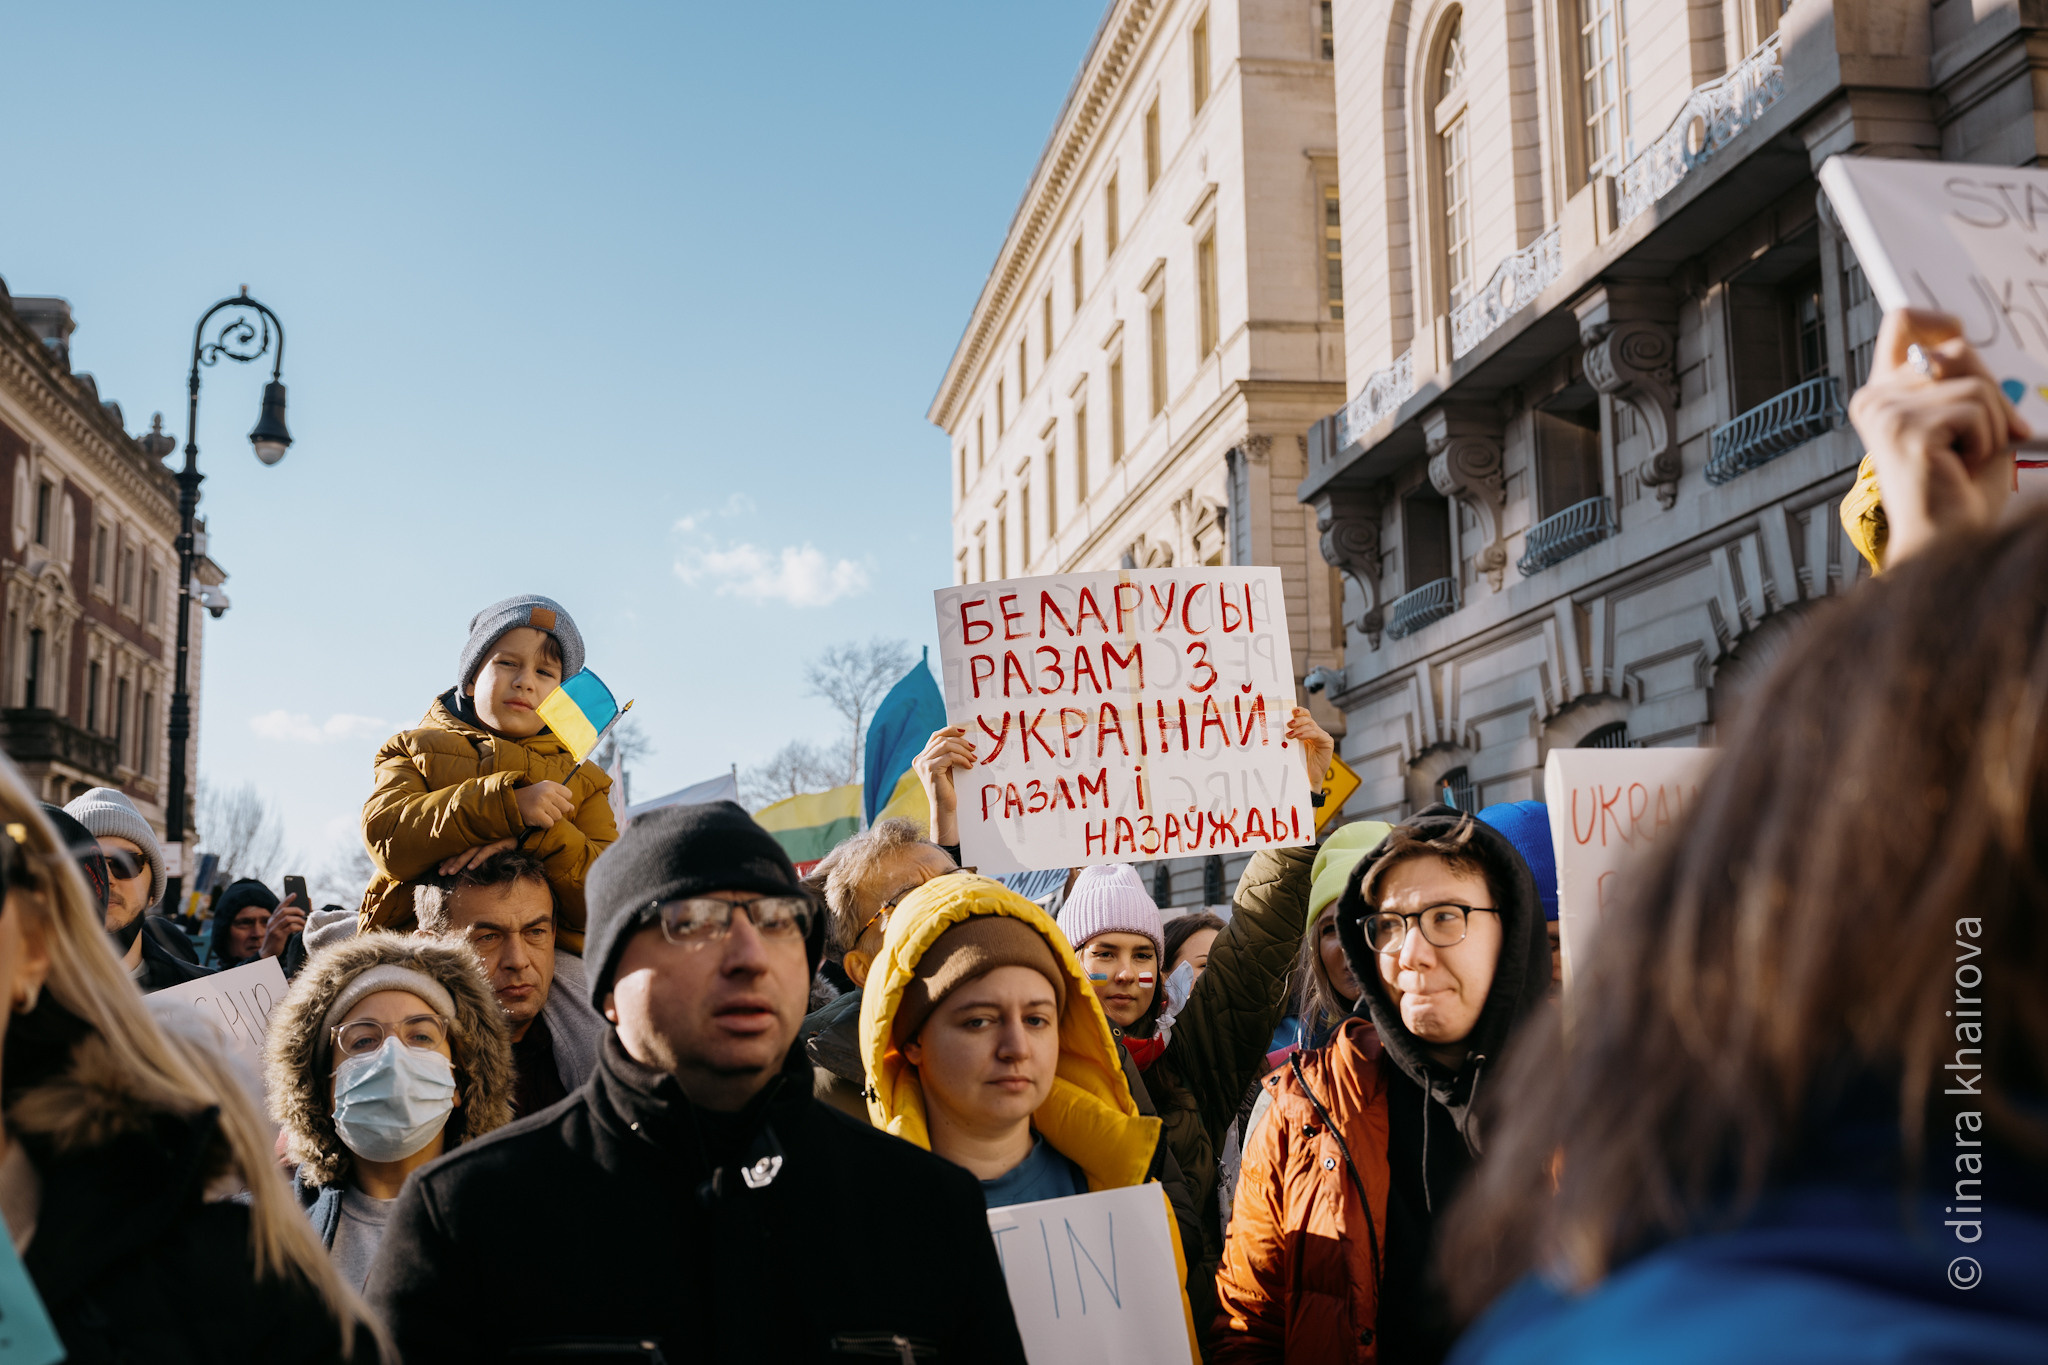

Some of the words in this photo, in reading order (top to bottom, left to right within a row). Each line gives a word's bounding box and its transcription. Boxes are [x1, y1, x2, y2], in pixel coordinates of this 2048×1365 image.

[959, 582, 1255, 646] БЕЛАРУСЫ
[969, 640, 1146, 699] РАЗАМ
[981, 767, 1110, 822] РАЗАМ
